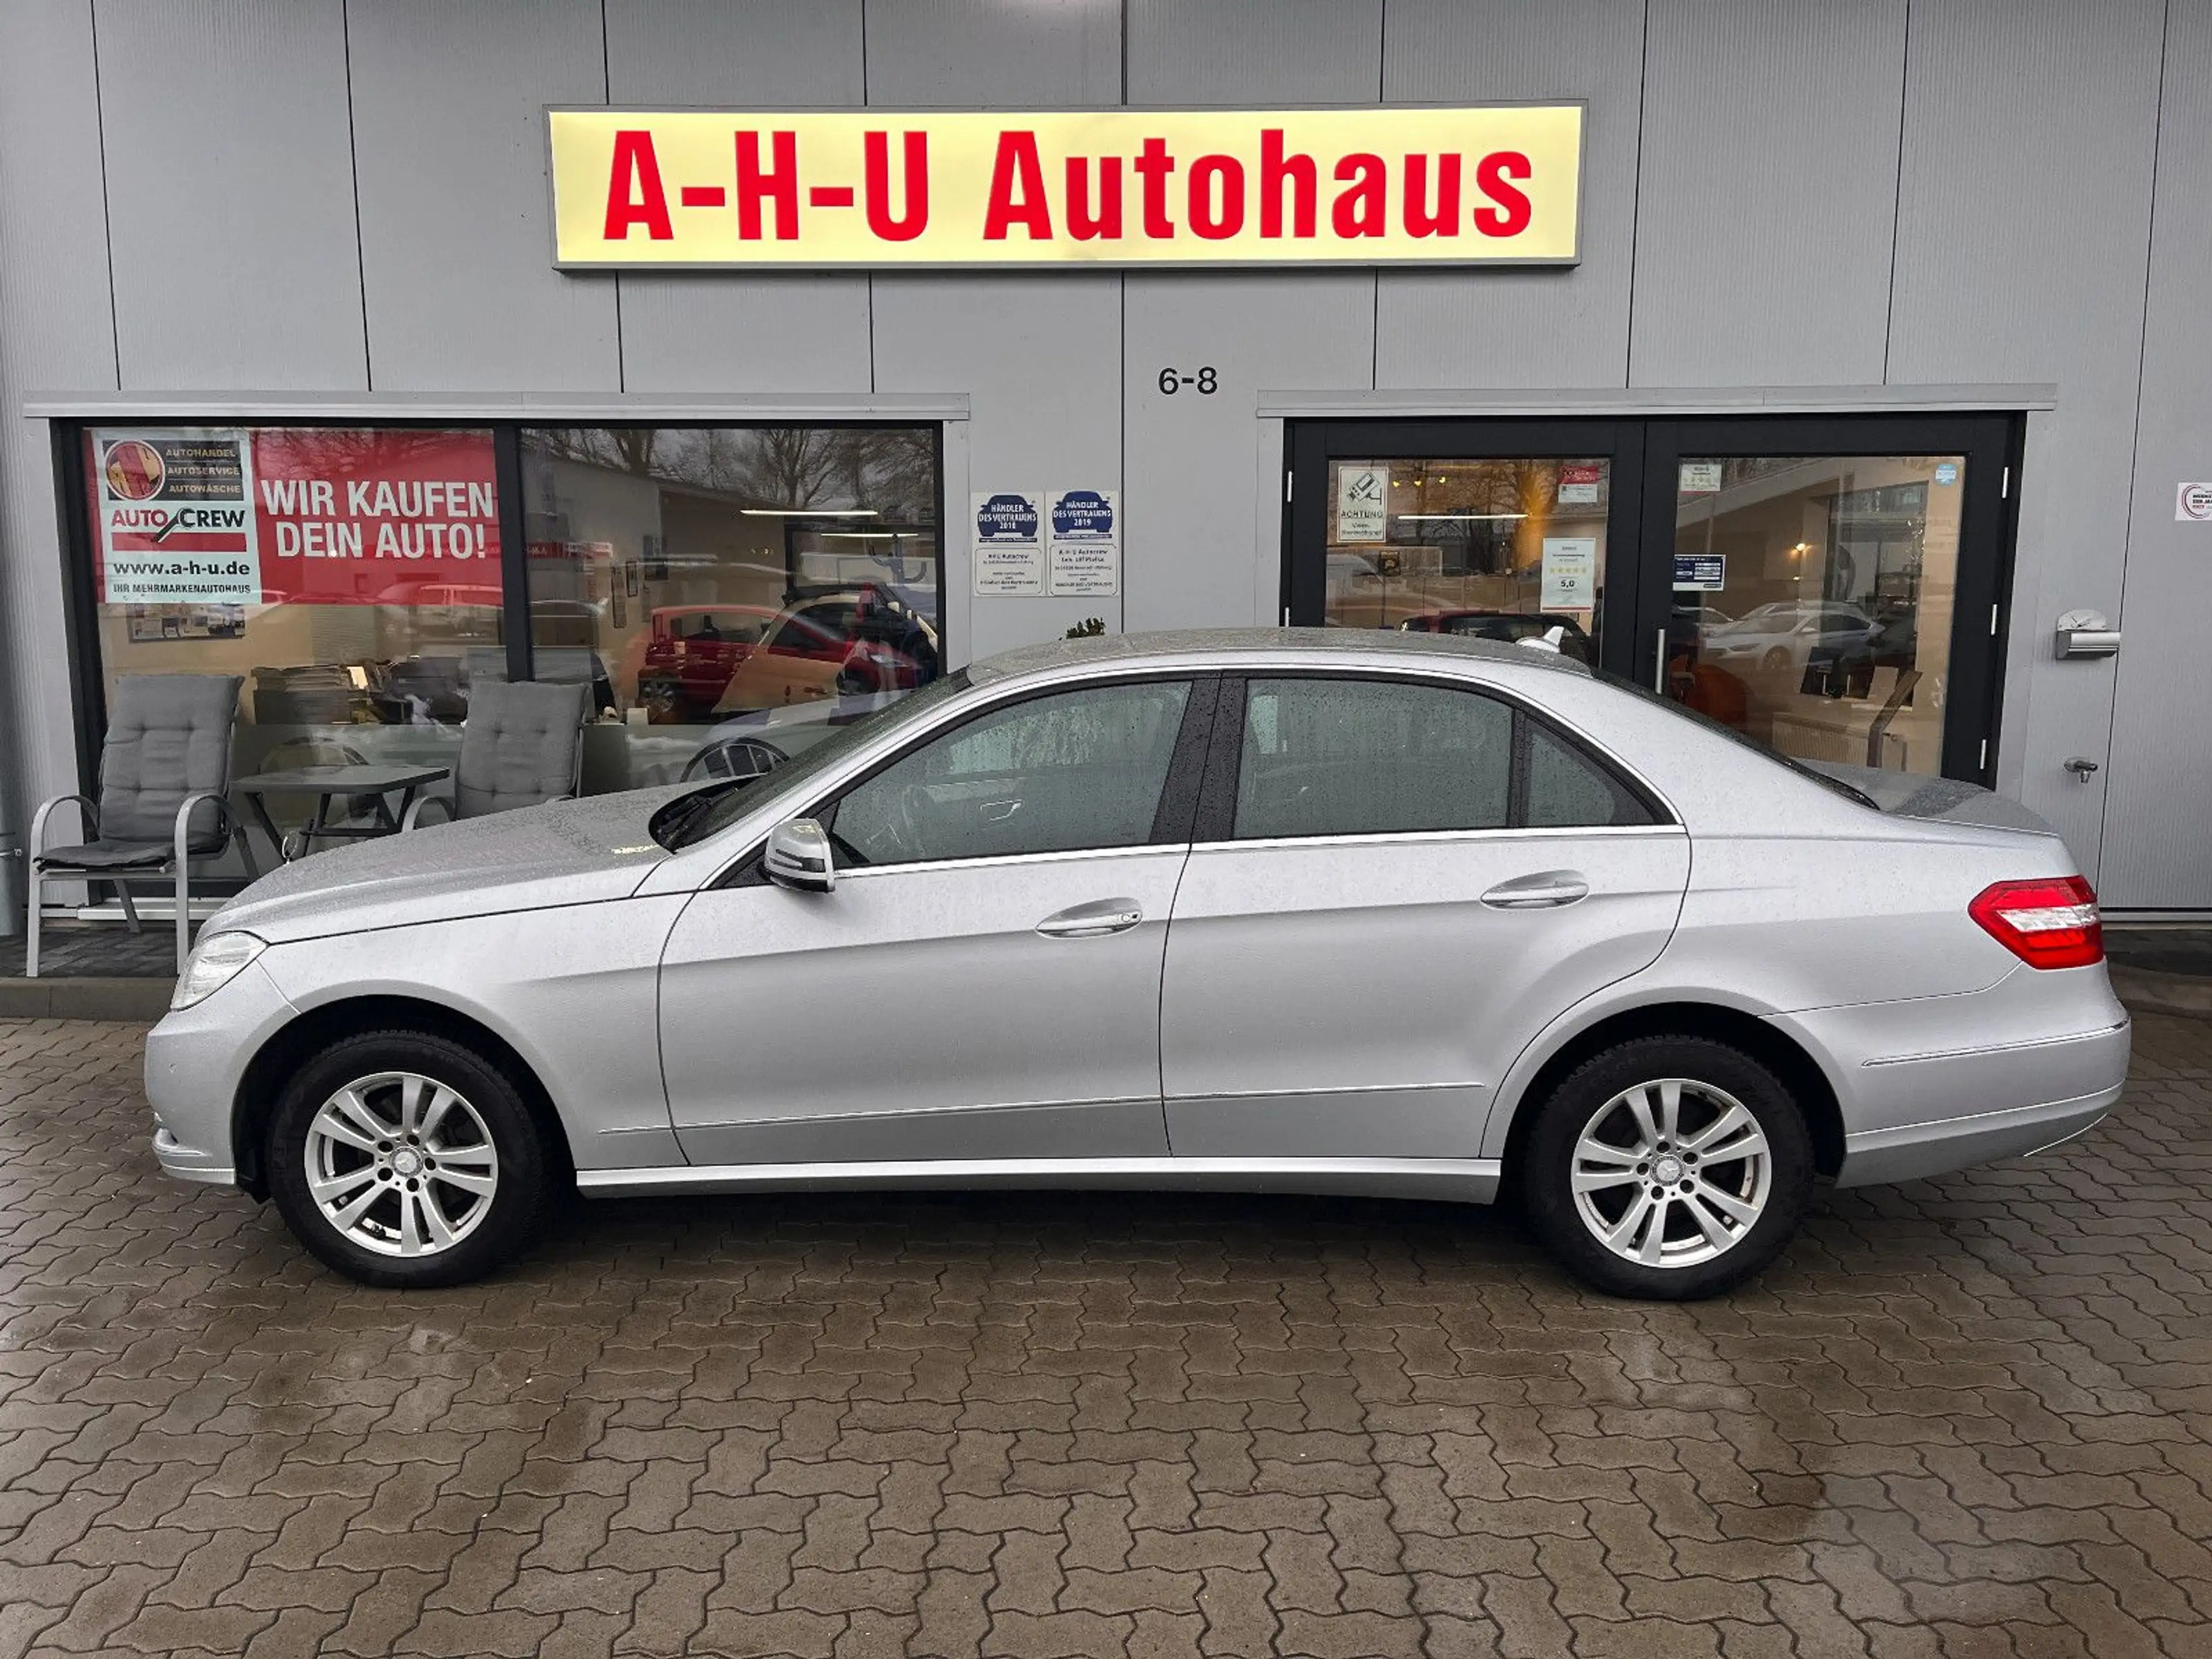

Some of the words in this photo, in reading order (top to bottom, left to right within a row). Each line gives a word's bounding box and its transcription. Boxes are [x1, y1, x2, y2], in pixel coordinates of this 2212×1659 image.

[604, 131, 927, 241] A-H-U
[984, 130, 1531, 240] Autohaus
[1159, 367, 1217, 395] 6-8
[165, 448, 236, 457] AUTOHANDEL
[168, 466, 240, 475] AUTOSERVICE
[260, 480, 336, 516] WIR
[347, 481, 493, 517] KAUFEN
[991, 503, 1024, 512] HÄNDLER
[1066, 500, 1099, 508] HÄNDLER
[111, 509, 168, 527] AUTO
[179, 508, 245, 528] CREW
[979, 513, 991, 522] DES
[993, 513, 1036, 521] VERTRAUENS
[1067, 510, 1111, 518] VERTRAUENS
[276, 521, 363, 558] DEIN
[376, 522, 485, 559] AUTO!
[113, 560, 250, 575] www.a-h-u.de
[113, 585, 130, 593] IHR
[132, 584, 251, 594] MEHRMARKENAUTOHAUS
